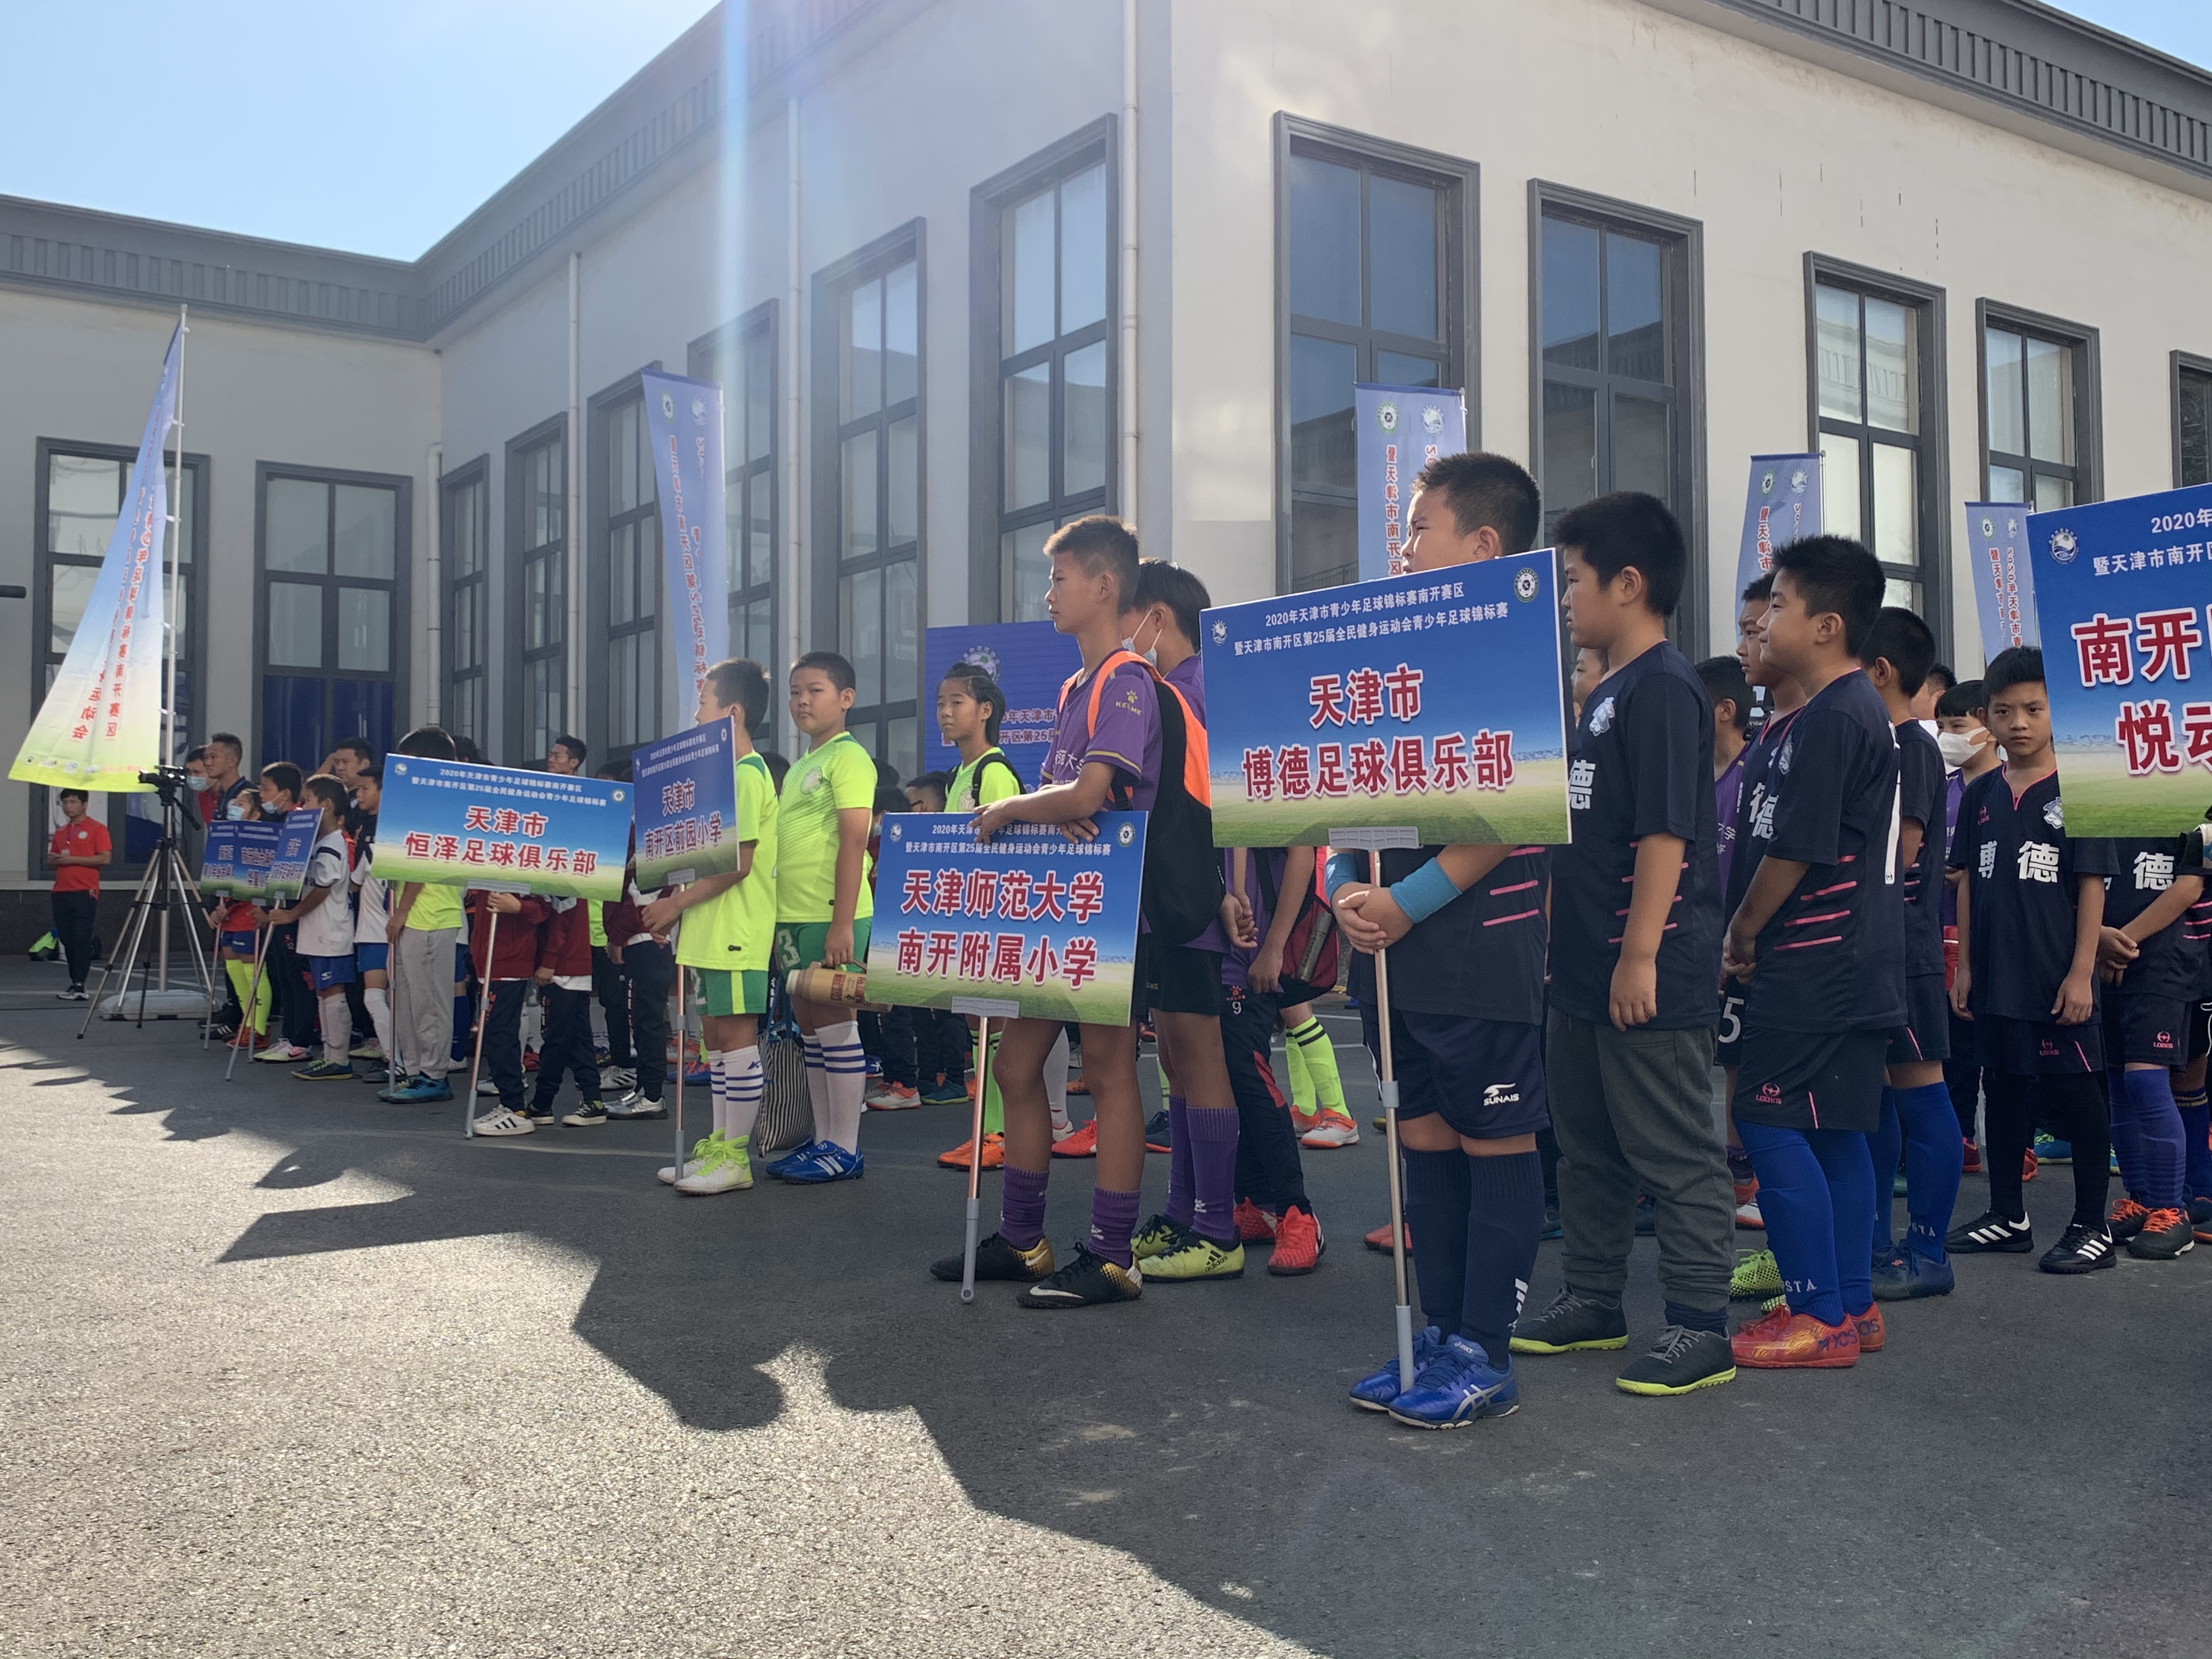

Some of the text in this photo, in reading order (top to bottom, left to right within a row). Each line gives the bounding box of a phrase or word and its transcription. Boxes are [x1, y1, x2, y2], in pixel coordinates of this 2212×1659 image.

[1265, 582, 1464, 626] 2020年天津市青少年足球锦标赛南开赛区
[1234, 601, 1509, 656] 暨天津市南开区第25届全民健身运动会青少年足球锦标赛
[2072, 606, 2212, 687] 南开
[1001, 708, 1057, 724] 年天津市
[1115, 701, 1142, 715] KELME
[1310, 663, 1423, 728] 天津市
[1242, 729, 1515, 800] 博德足球俱乐部
[662, 777, 696, 817] 天津市
[464, 805, 549, 838] 天津市
[404, 831, 599, 877] 恒泽足球俱乐部
[901, 868, 1104, 924] 天津师范大学
[896, 927, 1097, 989] 南开附属小学
[1232, 1001, 1242, 1015] 9
[1718, 996, 1745, 1043] 5
[1483, 1093, 1520, 1107] SUNAIS
[1756, 1094, 1782, 1104] LOOKS
